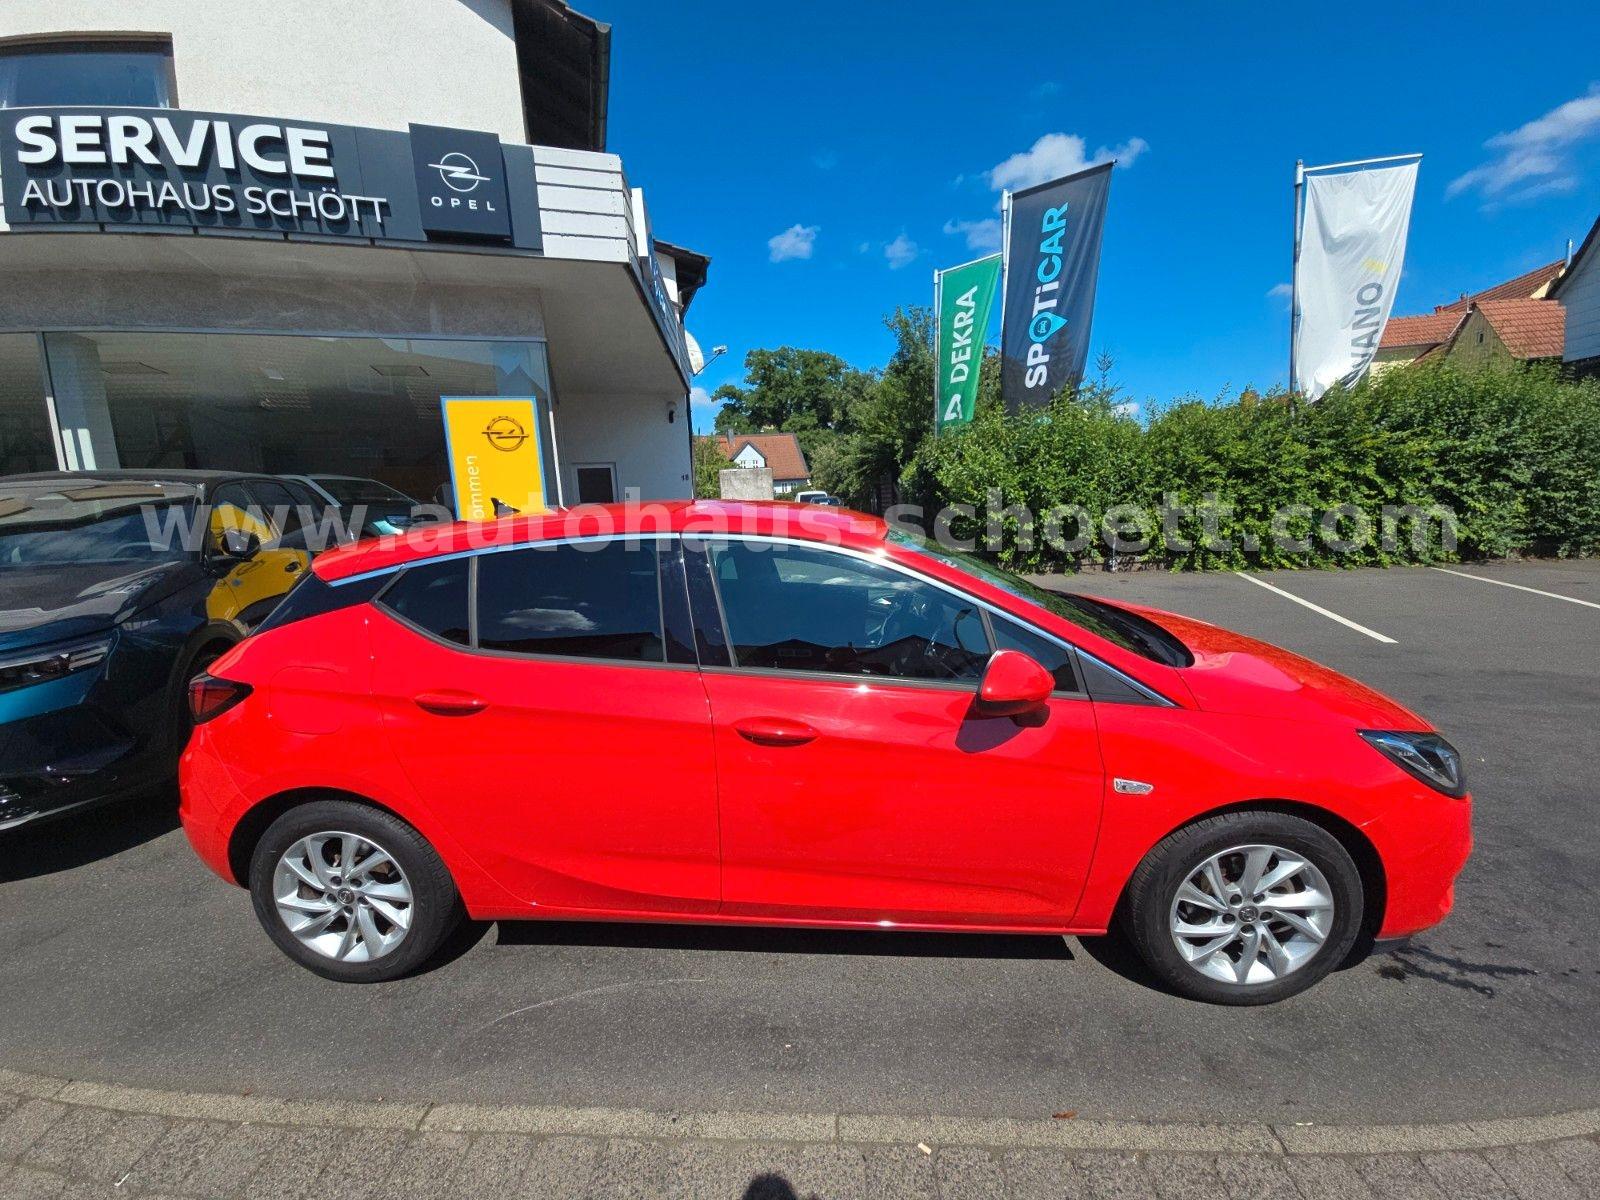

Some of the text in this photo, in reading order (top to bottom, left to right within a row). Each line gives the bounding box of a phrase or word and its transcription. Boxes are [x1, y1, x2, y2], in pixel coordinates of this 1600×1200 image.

[15, 115, 335, 178] SERVICE
[21, 179, 387, 223] AUTOHAUS SCHÖTT
[431, 196, 496, 212] OPEL
[950, 285, 978, 384] DEKRA
